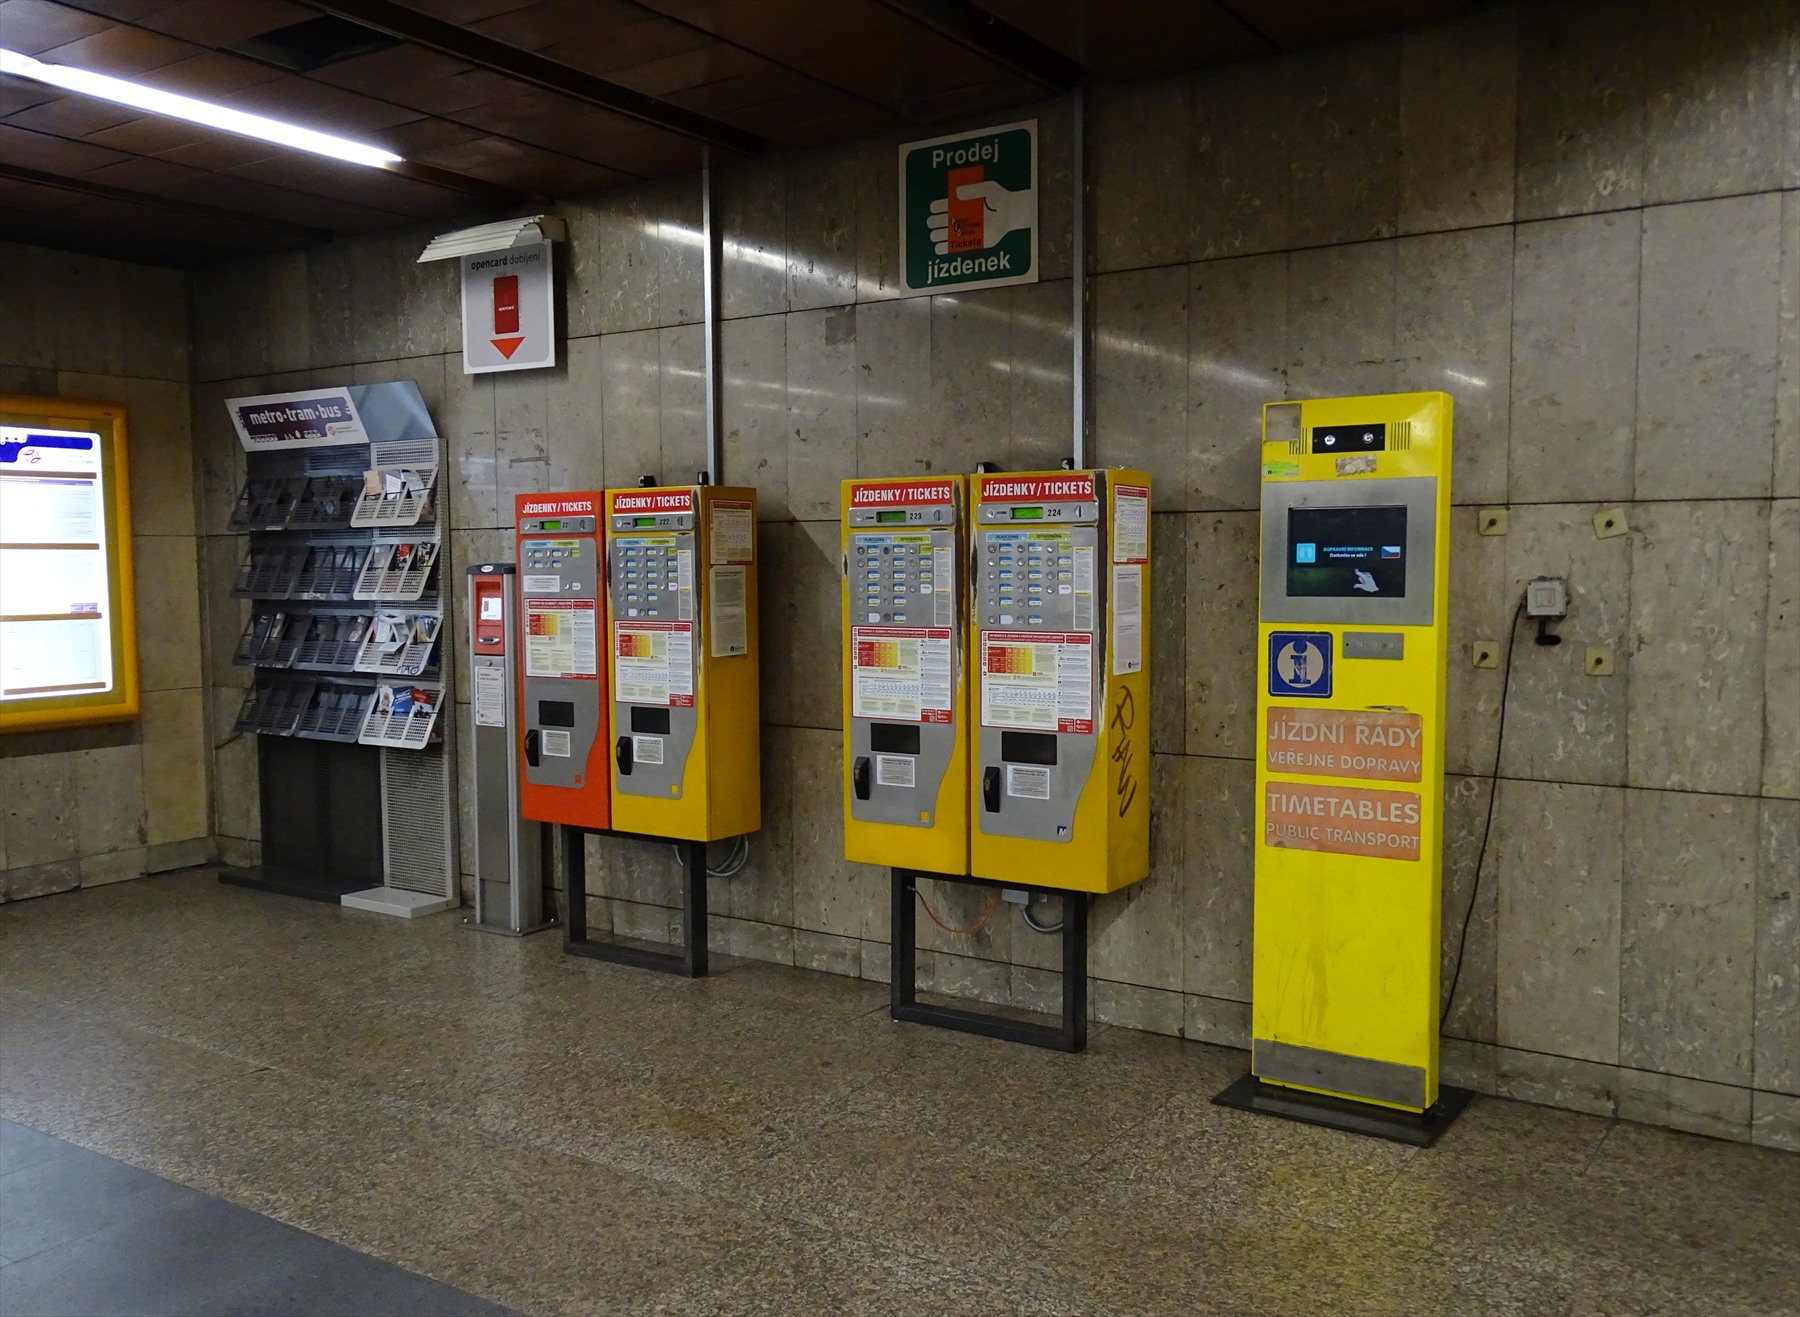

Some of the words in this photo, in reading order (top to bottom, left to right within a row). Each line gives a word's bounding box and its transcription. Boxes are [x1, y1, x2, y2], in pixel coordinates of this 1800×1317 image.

[932, 138, 1000, 169] Prodej
[471, 256, 507, 271] opencard
[926, 251, 1011, 284] jízdenek
[659, 518, 670, 526] 222
[909, 512, 922, 520] 223
[1047, 508, 1062, 517] 224
[1269, 715, 1345, 744] JÍZDNÍ
[1355, 717, 1422, 748] ŘÁDY
[1267, 747, 1335, 768] VEŘEJNÉ
[1340, 755, 1422, 775] DOPRAVY
[1267, 792, 1420, 825] TIMETABLES
[1266, 822, 1320, 840] PUBLIC
[1325, 827, 1420, 850] TRANSPORT
